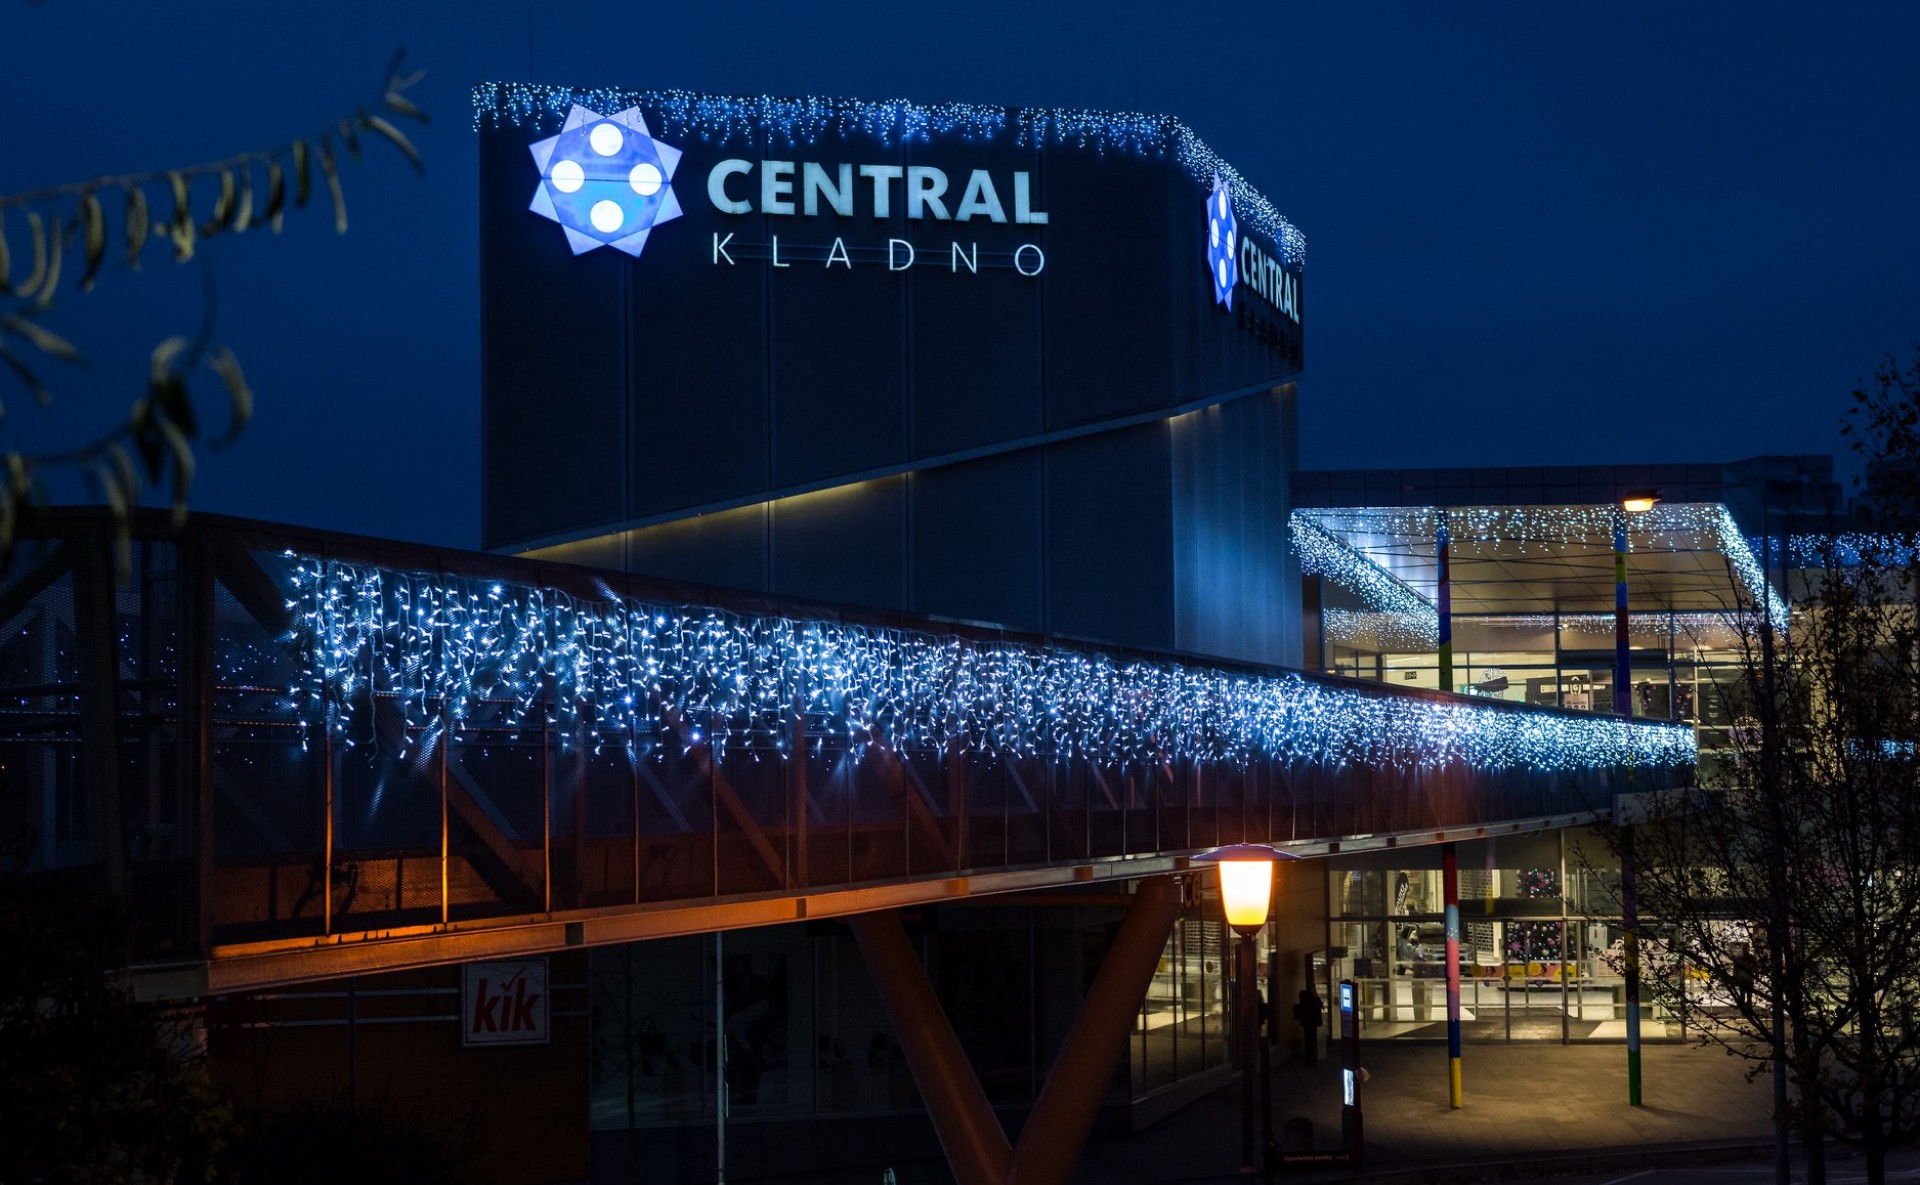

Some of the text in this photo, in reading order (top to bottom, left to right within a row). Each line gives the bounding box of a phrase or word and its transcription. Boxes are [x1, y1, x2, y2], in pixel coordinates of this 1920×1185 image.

[707, 158, 1049, 225] CENTRAL
[712, 232, 1046, 277] KLADNO
[1241, 235, 1300, 326] CENTRAL
